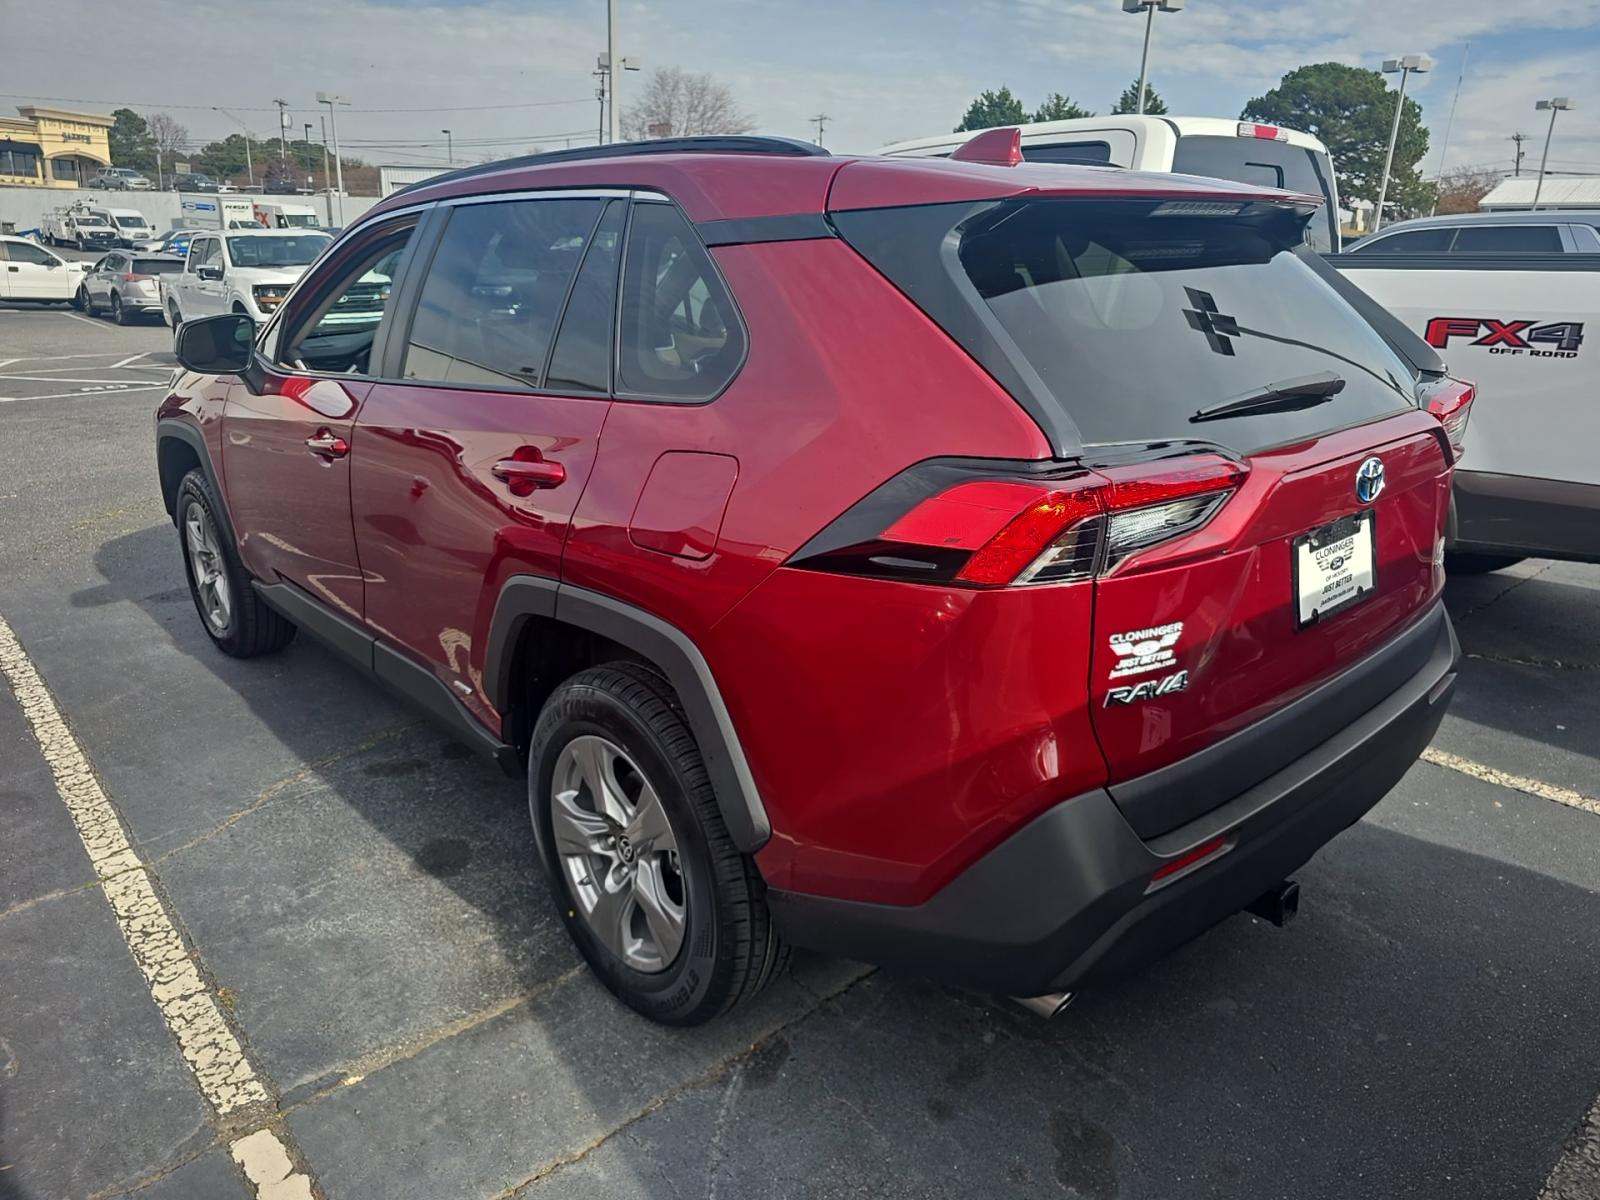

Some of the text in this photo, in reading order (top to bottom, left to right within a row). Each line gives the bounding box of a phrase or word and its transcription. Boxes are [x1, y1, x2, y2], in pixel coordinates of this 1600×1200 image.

[1424, 317, 1584, 350] FX4
[1529, 350, 1578, 359] ROAD
[1315, 538, 1354, 560] CLONINGER
[1321, 574, 1353, 594] JUST BETTER
[1109, 621, 1184, 643] CLONINGER
[1115, 658, 1140, 669] JUST
[1102, 670, 1188, 708] RAV4
